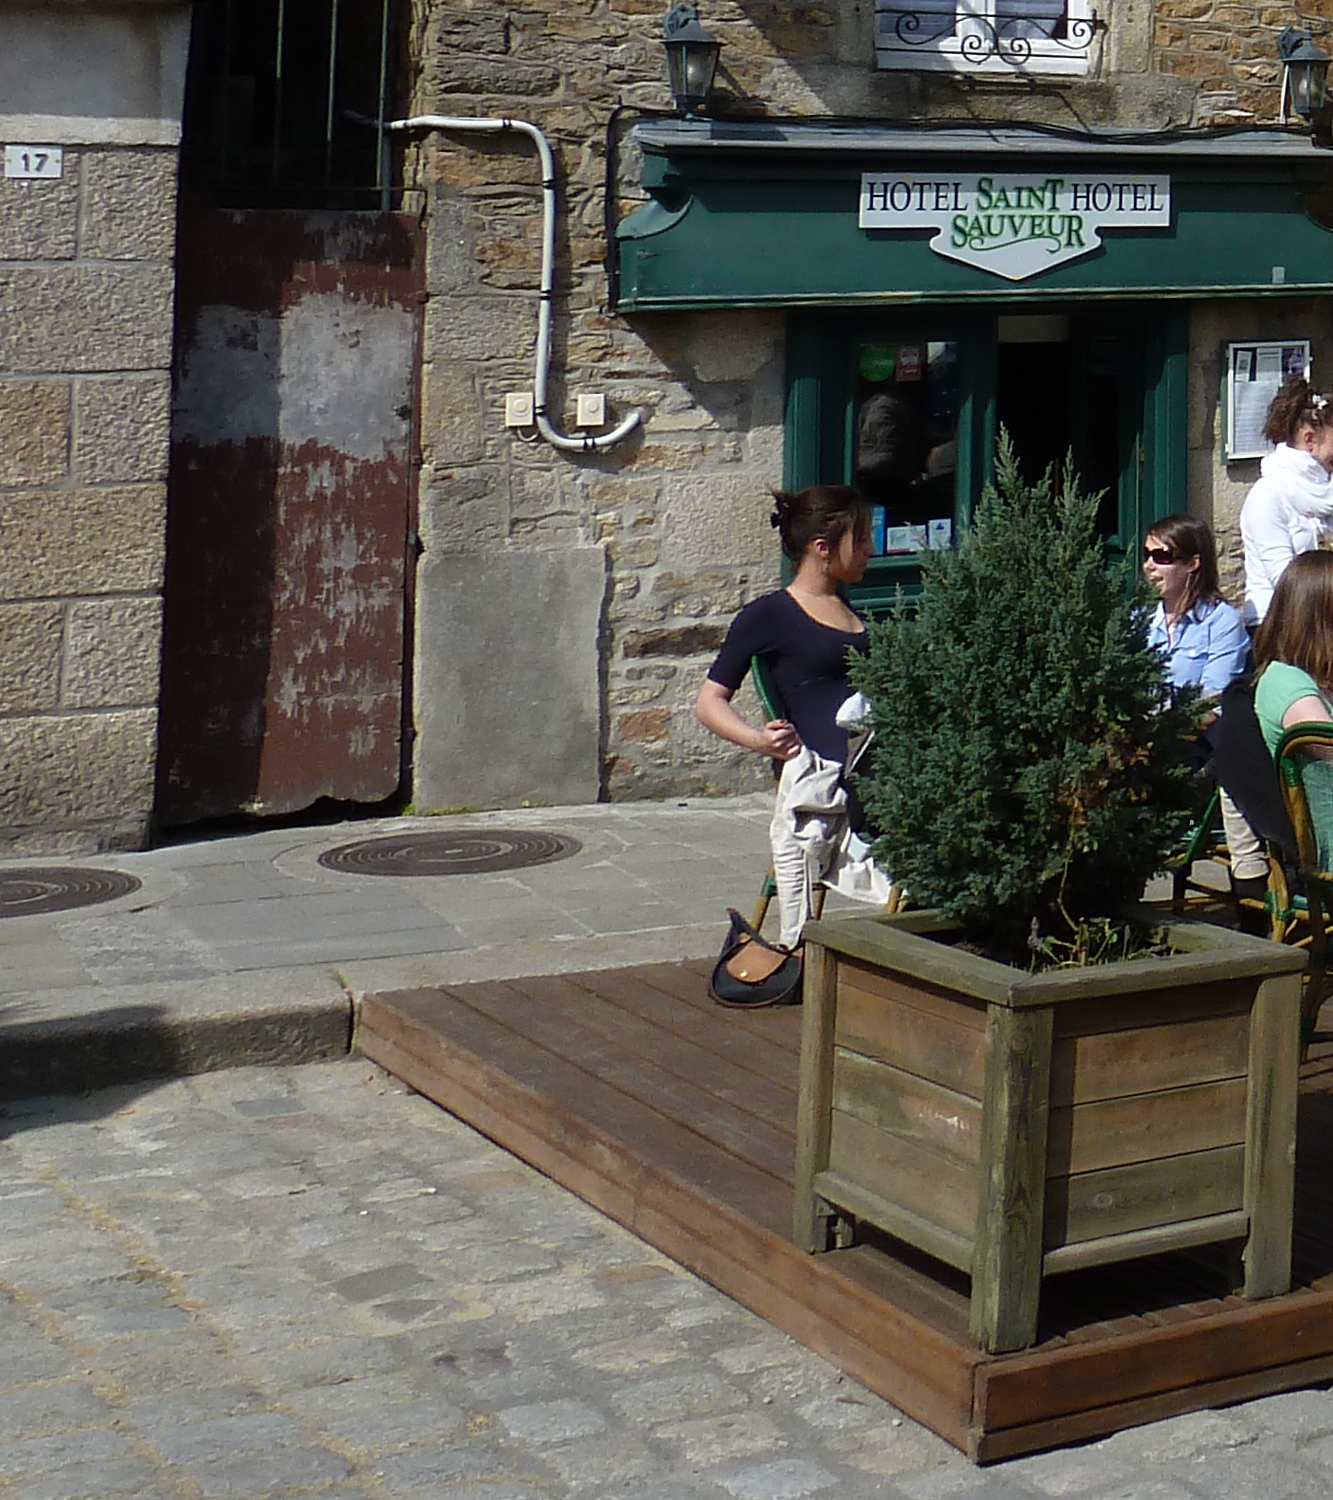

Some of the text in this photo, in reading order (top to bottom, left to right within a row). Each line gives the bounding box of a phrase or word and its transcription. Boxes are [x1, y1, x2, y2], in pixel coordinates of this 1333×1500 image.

[21, 152, 49, 172] 17
[866, 181, 969, 212] HOTEL
[1070, 182, 1164, 212] HOTEL
[951, 214, 1086, 250] SAUVEUR
